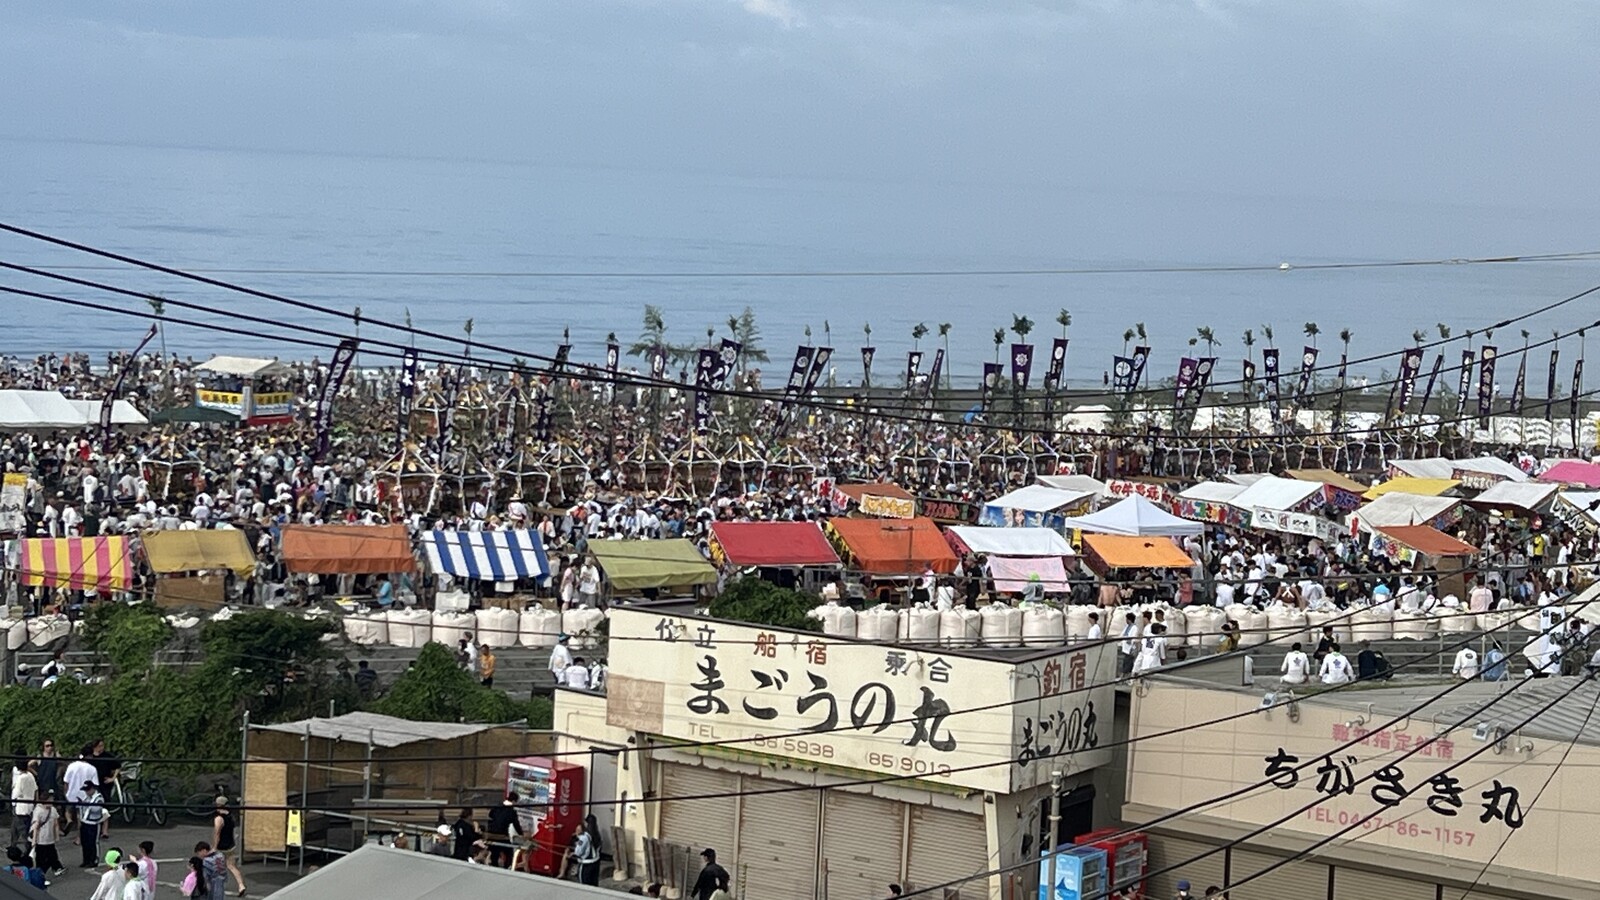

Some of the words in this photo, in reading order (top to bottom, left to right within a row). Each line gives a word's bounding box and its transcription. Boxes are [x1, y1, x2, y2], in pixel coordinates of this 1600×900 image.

[655, 618, 717, 649] 仕立
[753, 632, 828, 665] 船宿
[1042, 652, 1087, 696] 釣宿
[686, 654, 957, 752] まごうの丸
[688, 722, 721, 740] TEL
[1018, 700, 1098, 767] まごうの丸
[1264, 747, 1524, 829] ちがさき丸
